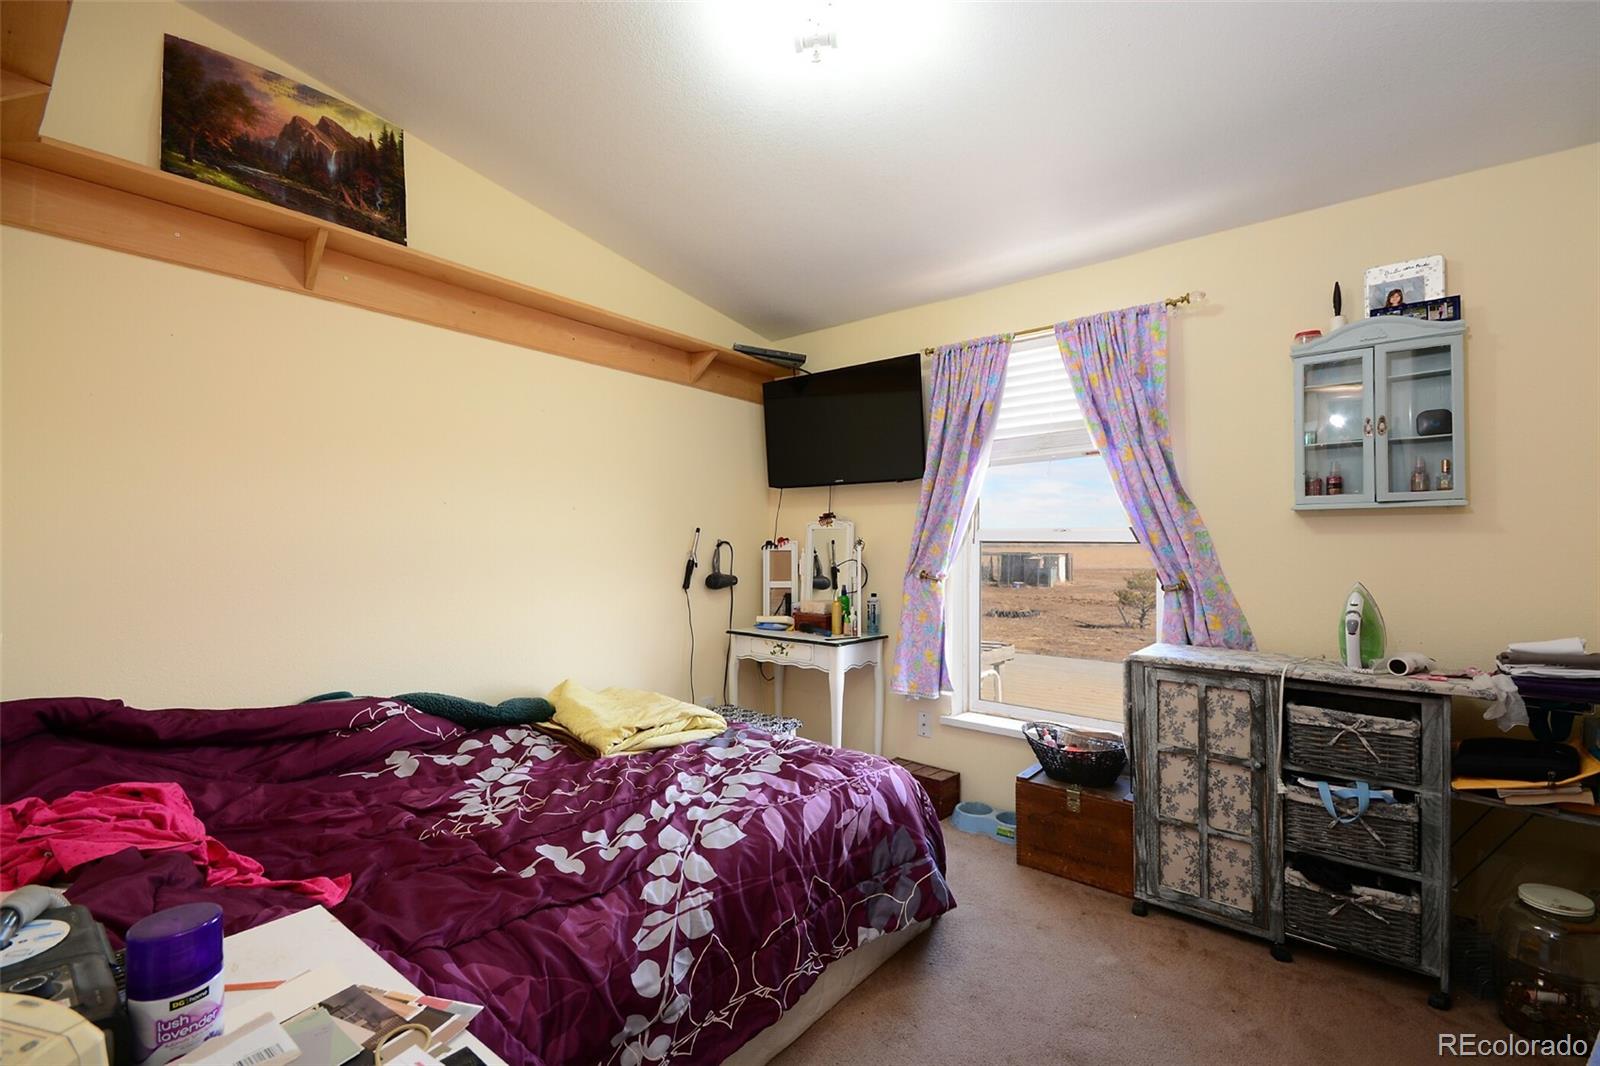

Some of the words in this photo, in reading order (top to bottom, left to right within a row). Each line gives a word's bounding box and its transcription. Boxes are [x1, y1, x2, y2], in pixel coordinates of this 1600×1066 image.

[172, 1000, 185, 1009] DG
[189, 989, 208, 1002] home
[157, 1015, 189, 1032] lush
[157, 1008, 218, 1043] lavender
